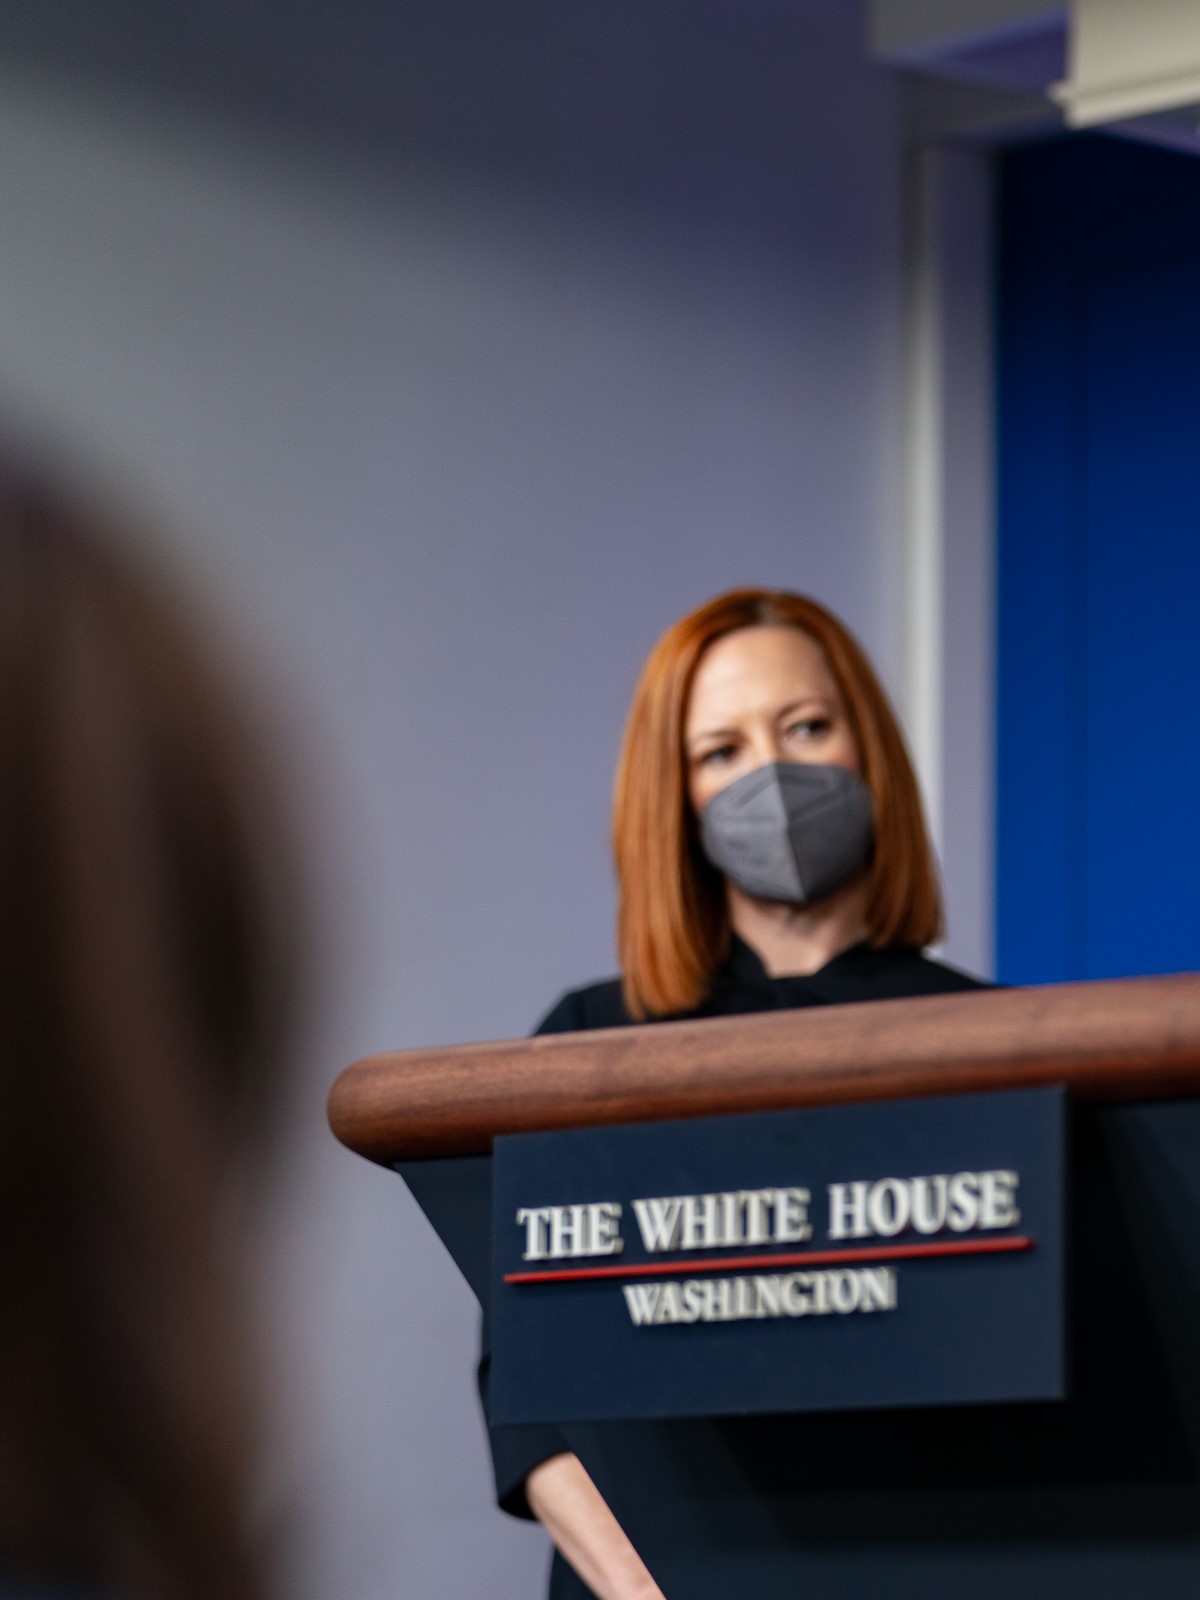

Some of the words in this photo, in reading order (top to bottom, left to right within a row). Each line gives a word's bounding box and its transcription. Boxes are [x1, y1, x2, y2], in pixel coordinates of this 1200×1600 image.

[517, 1202, 623, 1261] THE
[633, 1187, 811, 1253] WHITE
[828, 1169, 1019, 1240] HOUSE
[623, 1267, 897, 1325] WASHINGTON
